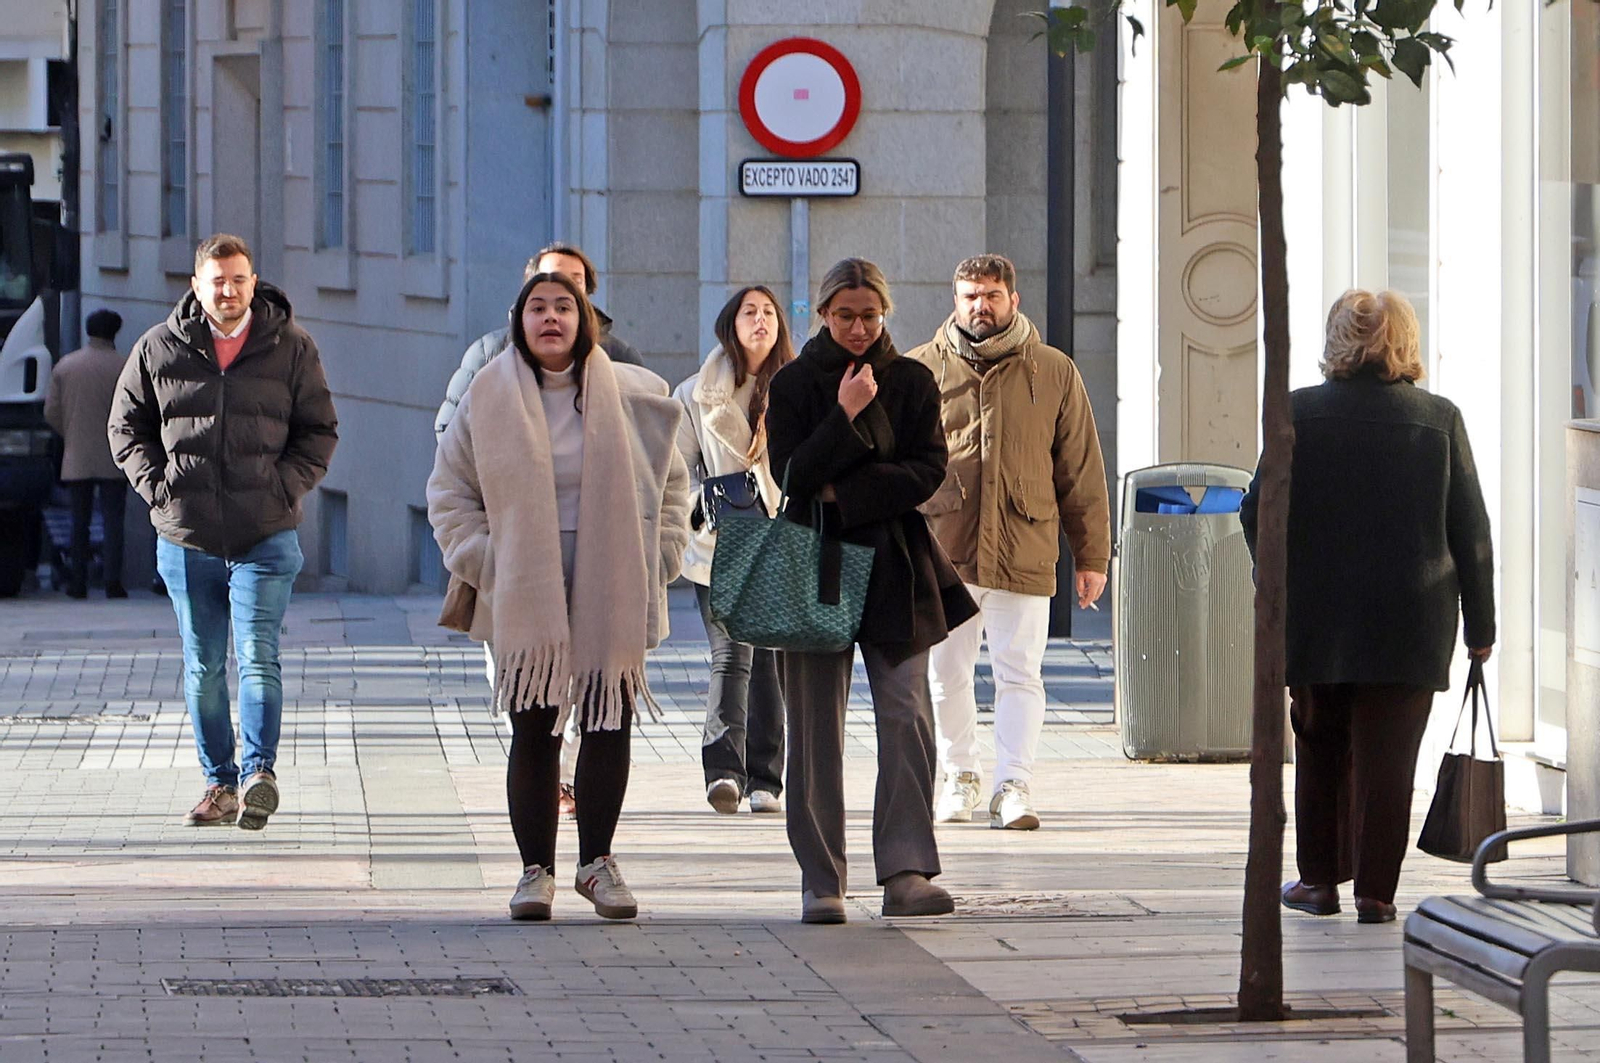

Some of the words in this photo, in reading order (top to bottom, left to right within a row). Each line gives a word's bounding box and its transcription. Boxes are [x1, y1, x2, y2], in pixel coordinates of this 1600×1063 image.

[744, 167, 795, 186] EXCEPTO
[797, 167, 828, 186] VADO
[831, 167, 854, 186] 2547
